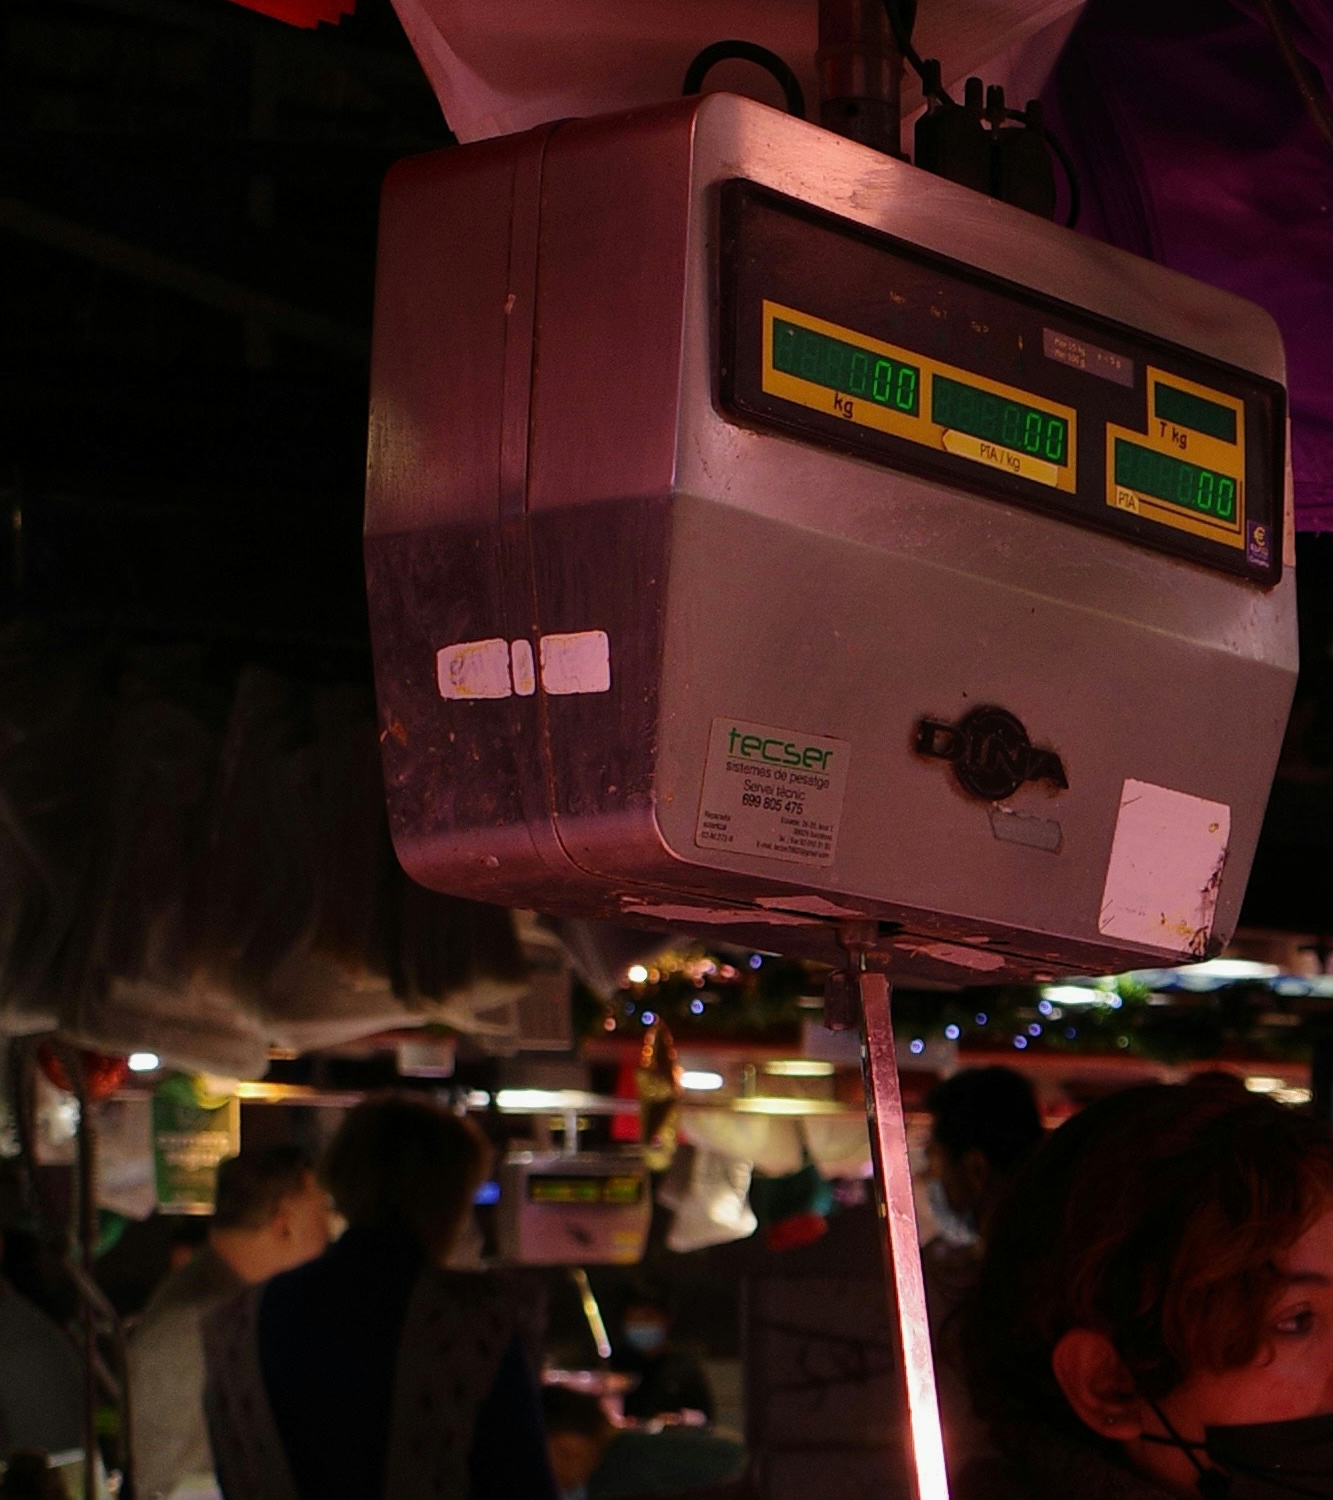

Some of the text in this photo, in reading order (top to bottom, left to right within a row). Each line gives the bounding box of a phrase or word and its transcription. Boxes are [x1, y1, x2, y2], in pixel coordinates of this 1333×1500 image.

[833, 393, 863, 418] kg
[1160, 421, 1188, 450] T kg
[728, 727, 833, 770] tecser
[916, 719, 1068, 789] DINA
[744, 779, 775, 796] Servei
[774, 770, 787, 780] de
[742, 793, 803, 815] 699 805 475
